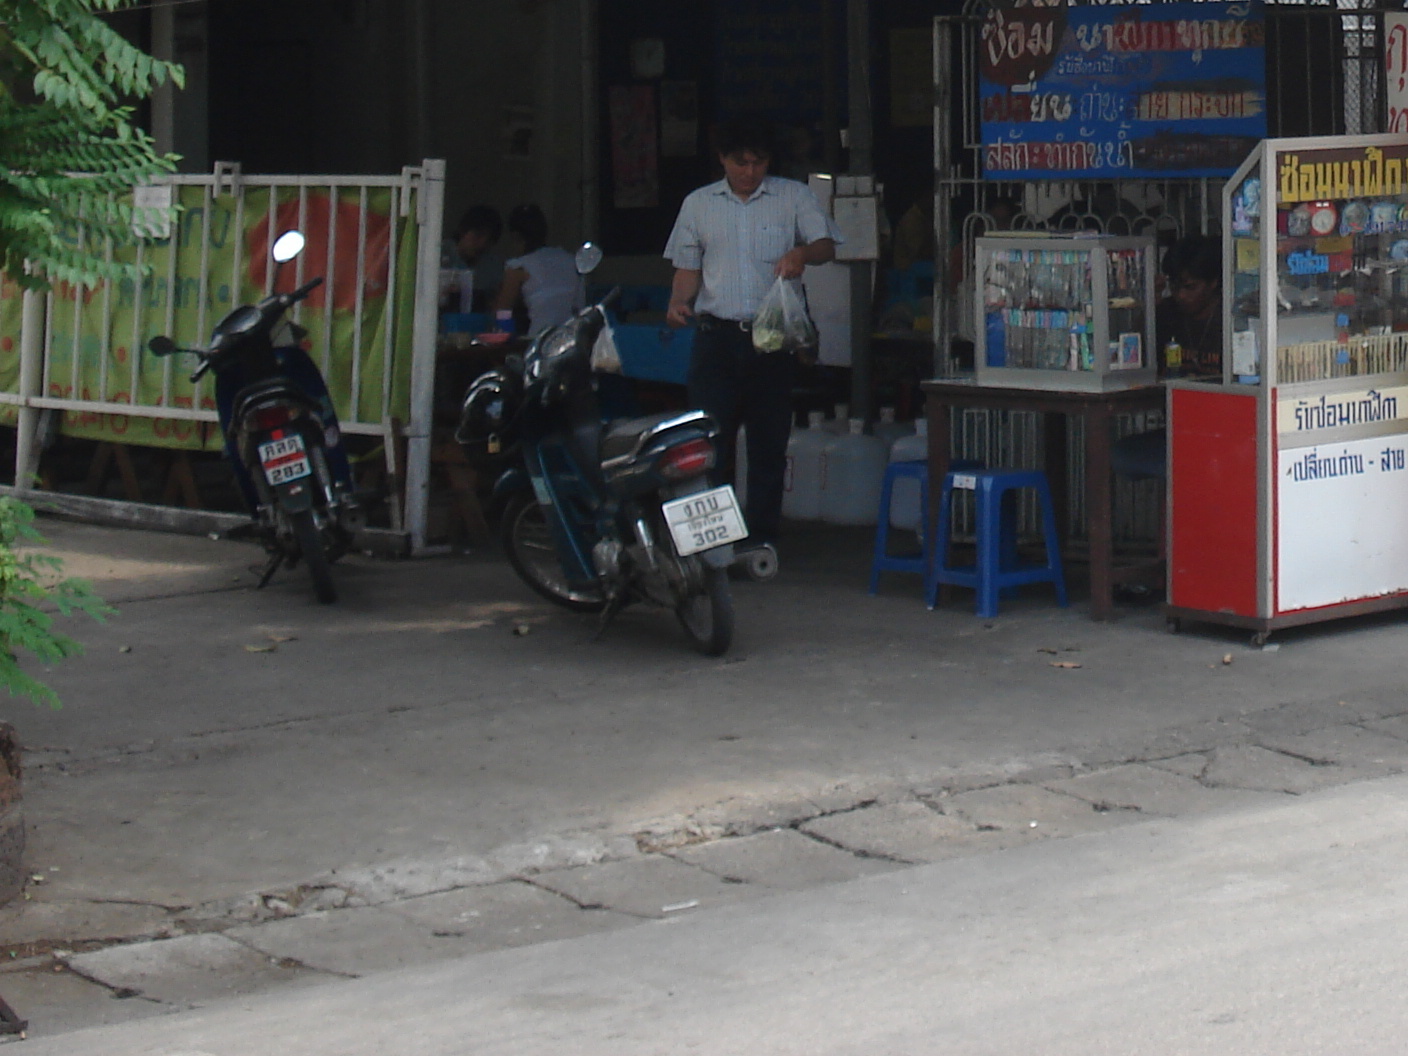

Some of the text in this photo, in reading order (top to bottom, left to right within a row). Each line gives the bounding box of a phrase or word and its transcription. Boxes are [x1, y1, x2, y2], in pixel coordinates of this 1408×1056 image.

[981, 7, 1055, 68] ซ่อม
[1295, 389, 1398, 431] รับซ่อมนาฬิกา
[1380, 447, 1405, 472] สาย
[693, 526, 730, 547] 302
